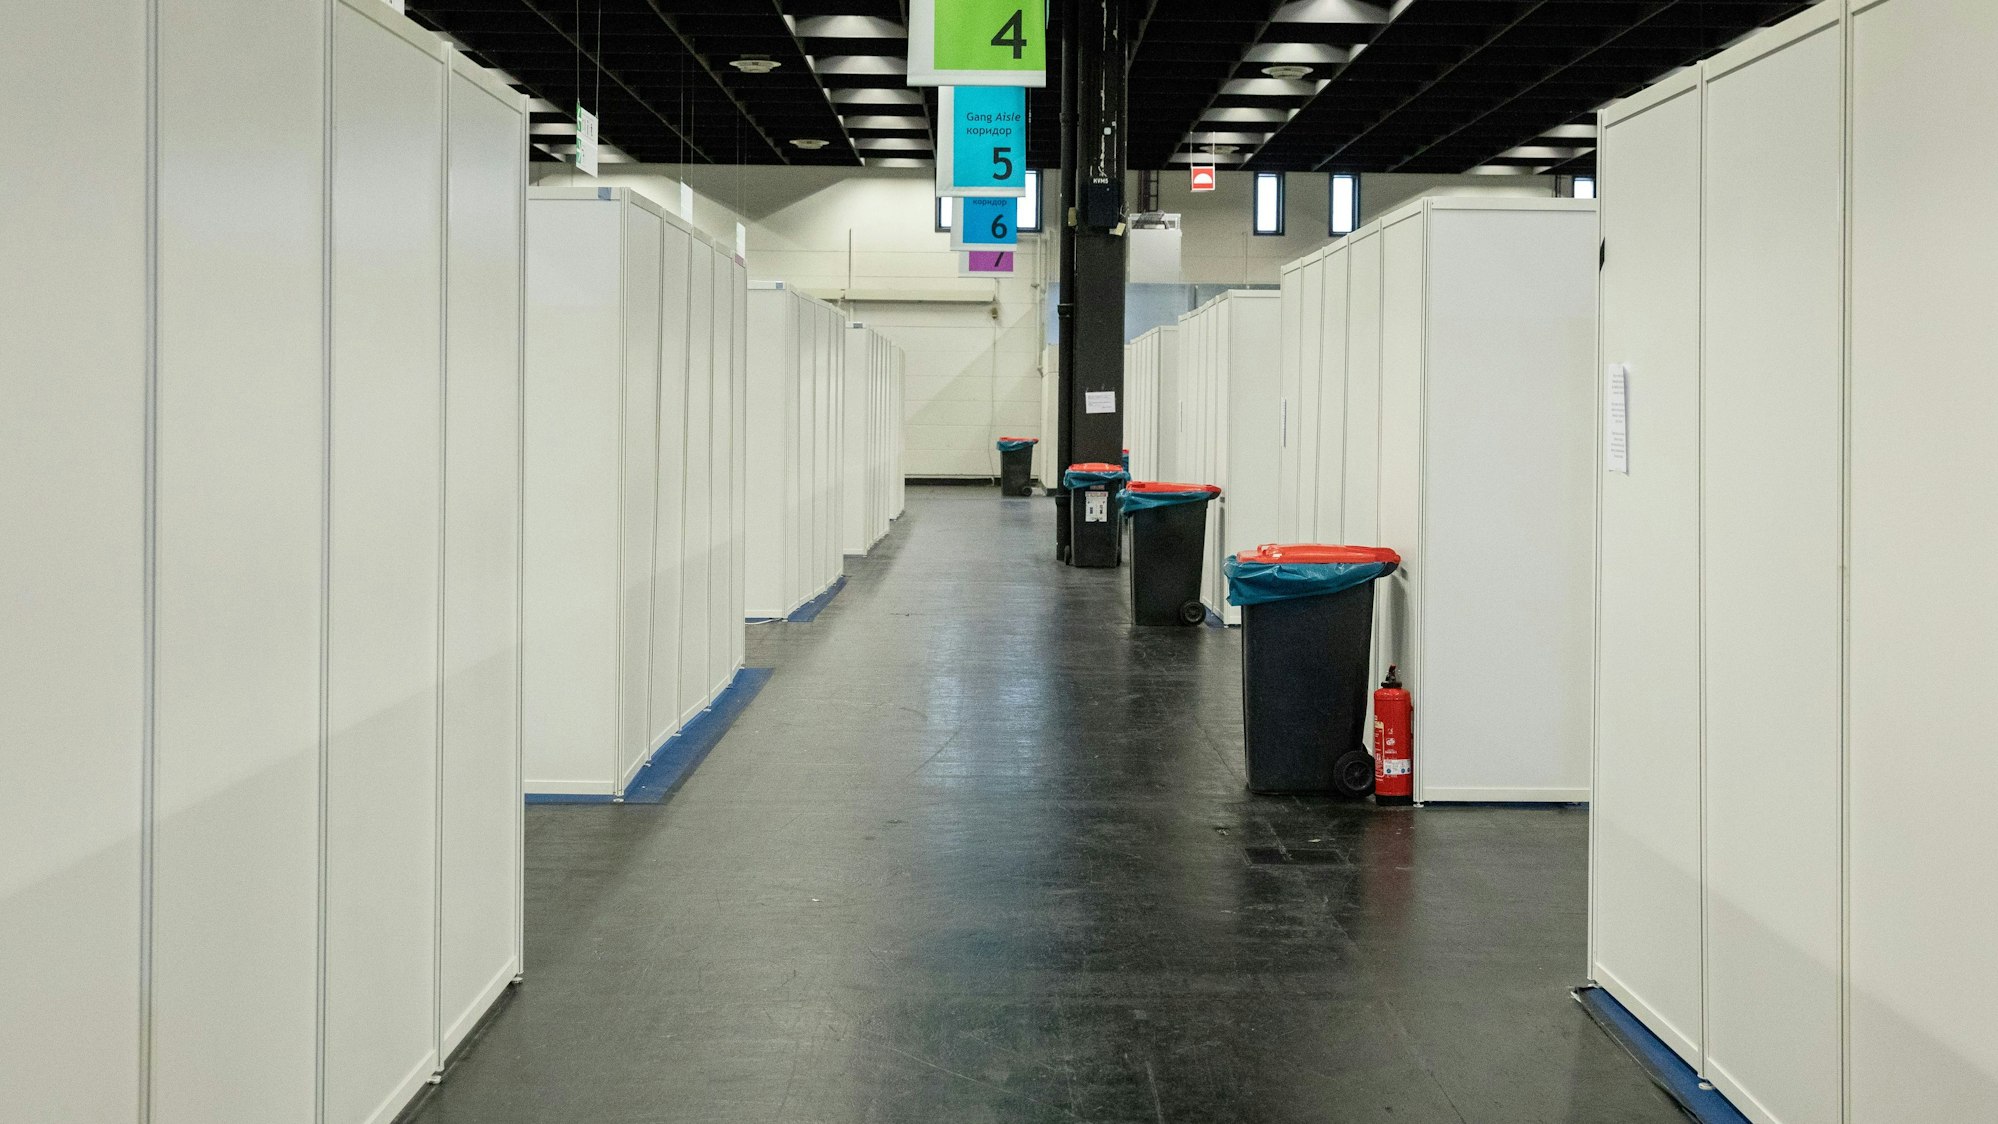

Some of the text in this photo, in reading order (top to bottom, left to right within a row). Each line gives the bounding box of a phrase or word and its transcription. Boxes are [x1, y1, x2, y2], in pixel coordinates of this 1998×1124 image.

[990, 9, 1027, 59] 4
[966, 112, 1021, 124] Gang Aisle
[966, 127, 1012, 137] коридор
[992, 147, 1013, 181] 5
[991, 214, 1008, 239] 6
